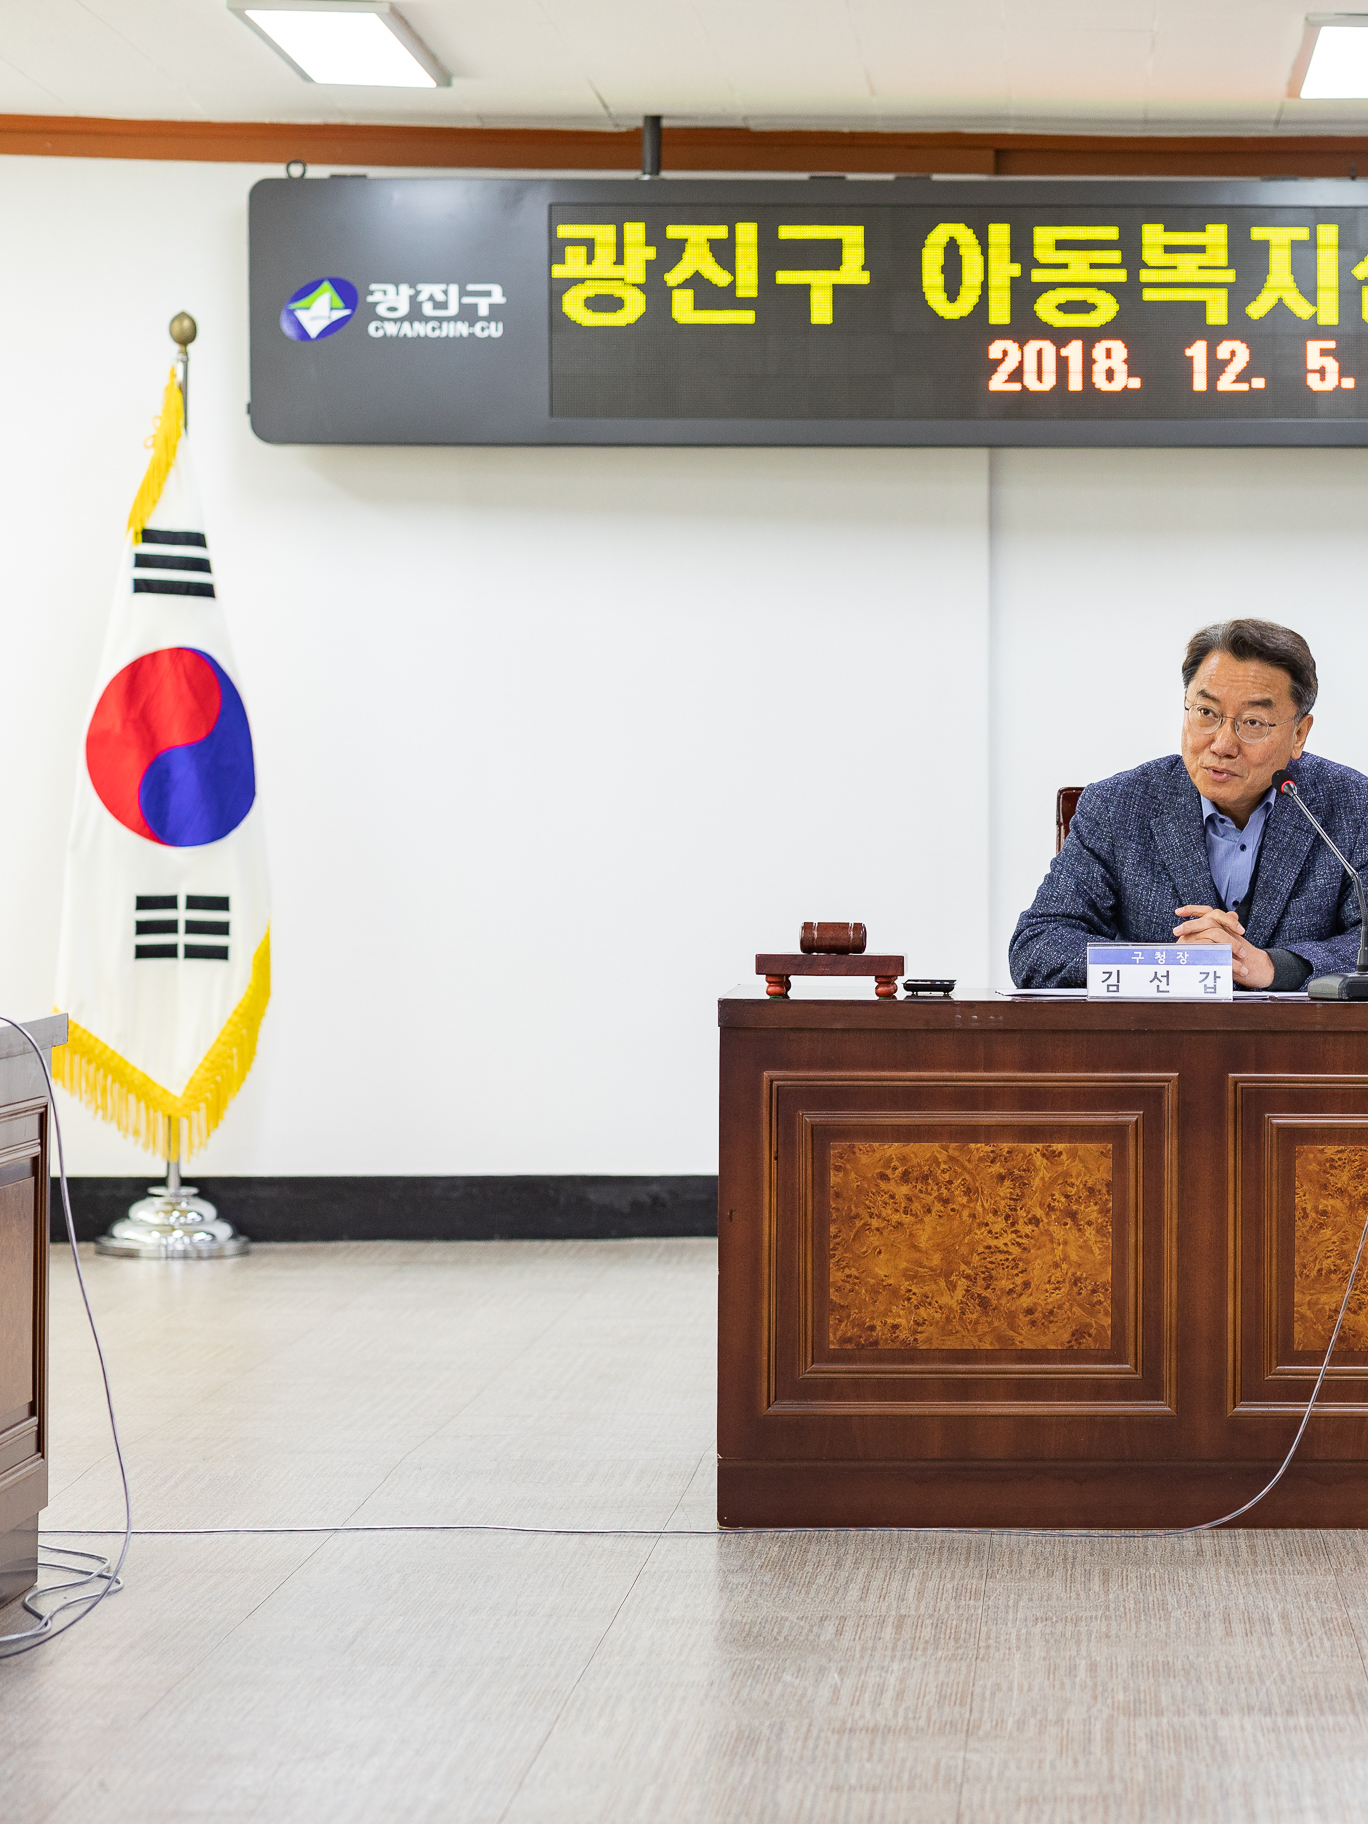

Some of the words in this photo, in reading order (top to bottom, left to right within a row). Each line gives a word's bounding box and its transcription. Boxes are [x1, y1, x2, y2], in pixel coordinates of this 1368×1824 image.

[366, 283, 507, 318] 광진구
[552, 221, 871, 327] 광진구
[987, 339, 1142, 392] 2018.
[1184, 339, 1267, 392] 12.
